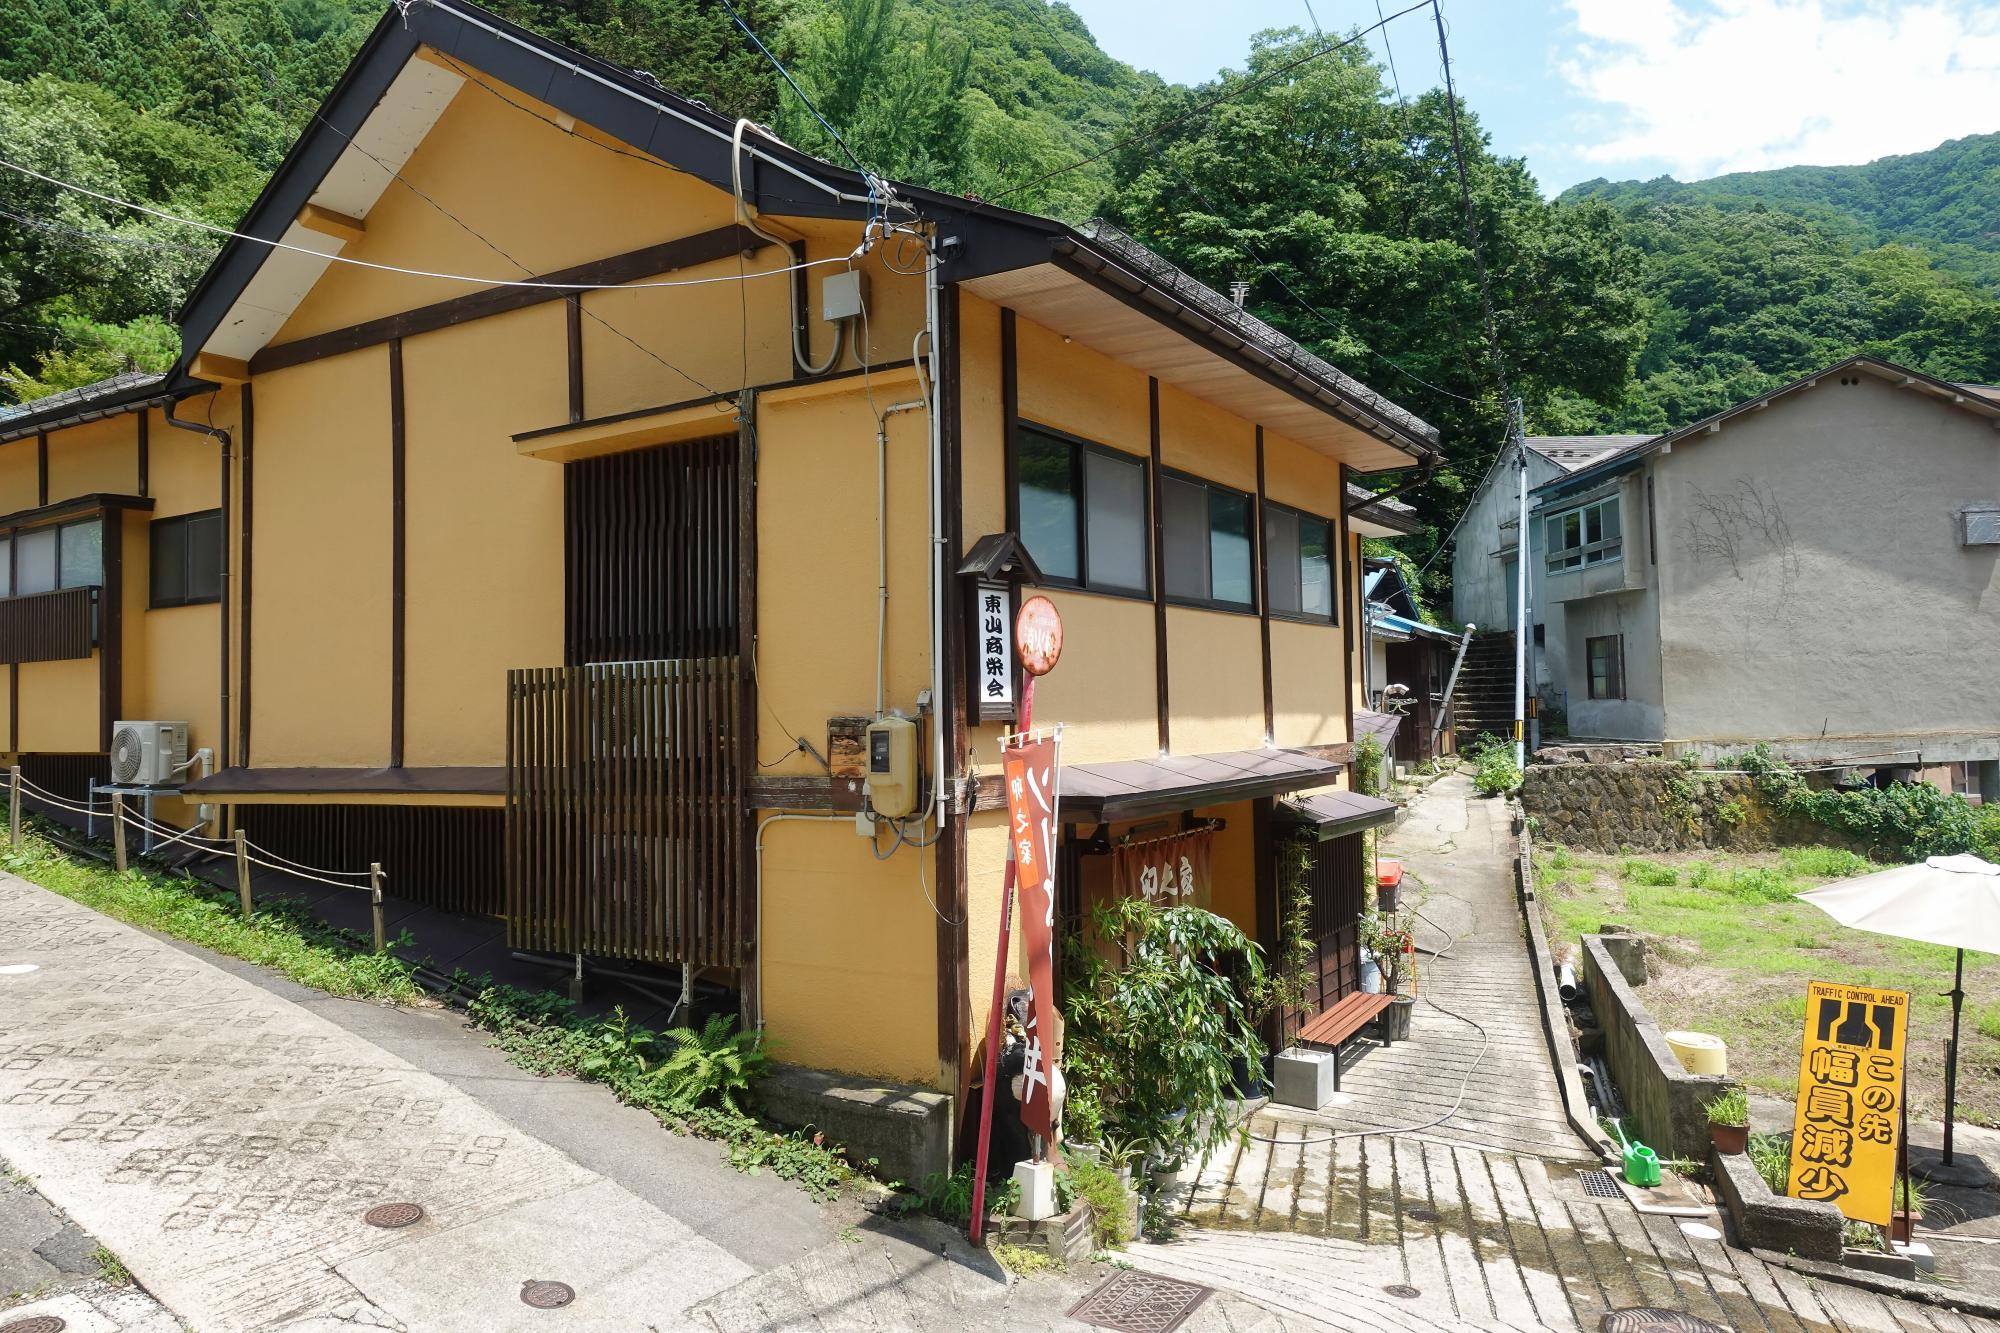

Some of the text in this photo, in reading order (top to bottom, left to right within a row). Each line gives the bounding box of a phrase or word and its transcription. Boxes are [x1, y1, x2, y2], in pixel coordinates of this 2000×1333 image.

[985, 595, 1004, 697] 東山商栄会
[1813, 986, 1904, 1006] TRAFFIC CONTROL AHEAD
[1798, 1047, 1859, 1201] 幅員減少
[1858, 1055, 1895, 1144] この先
